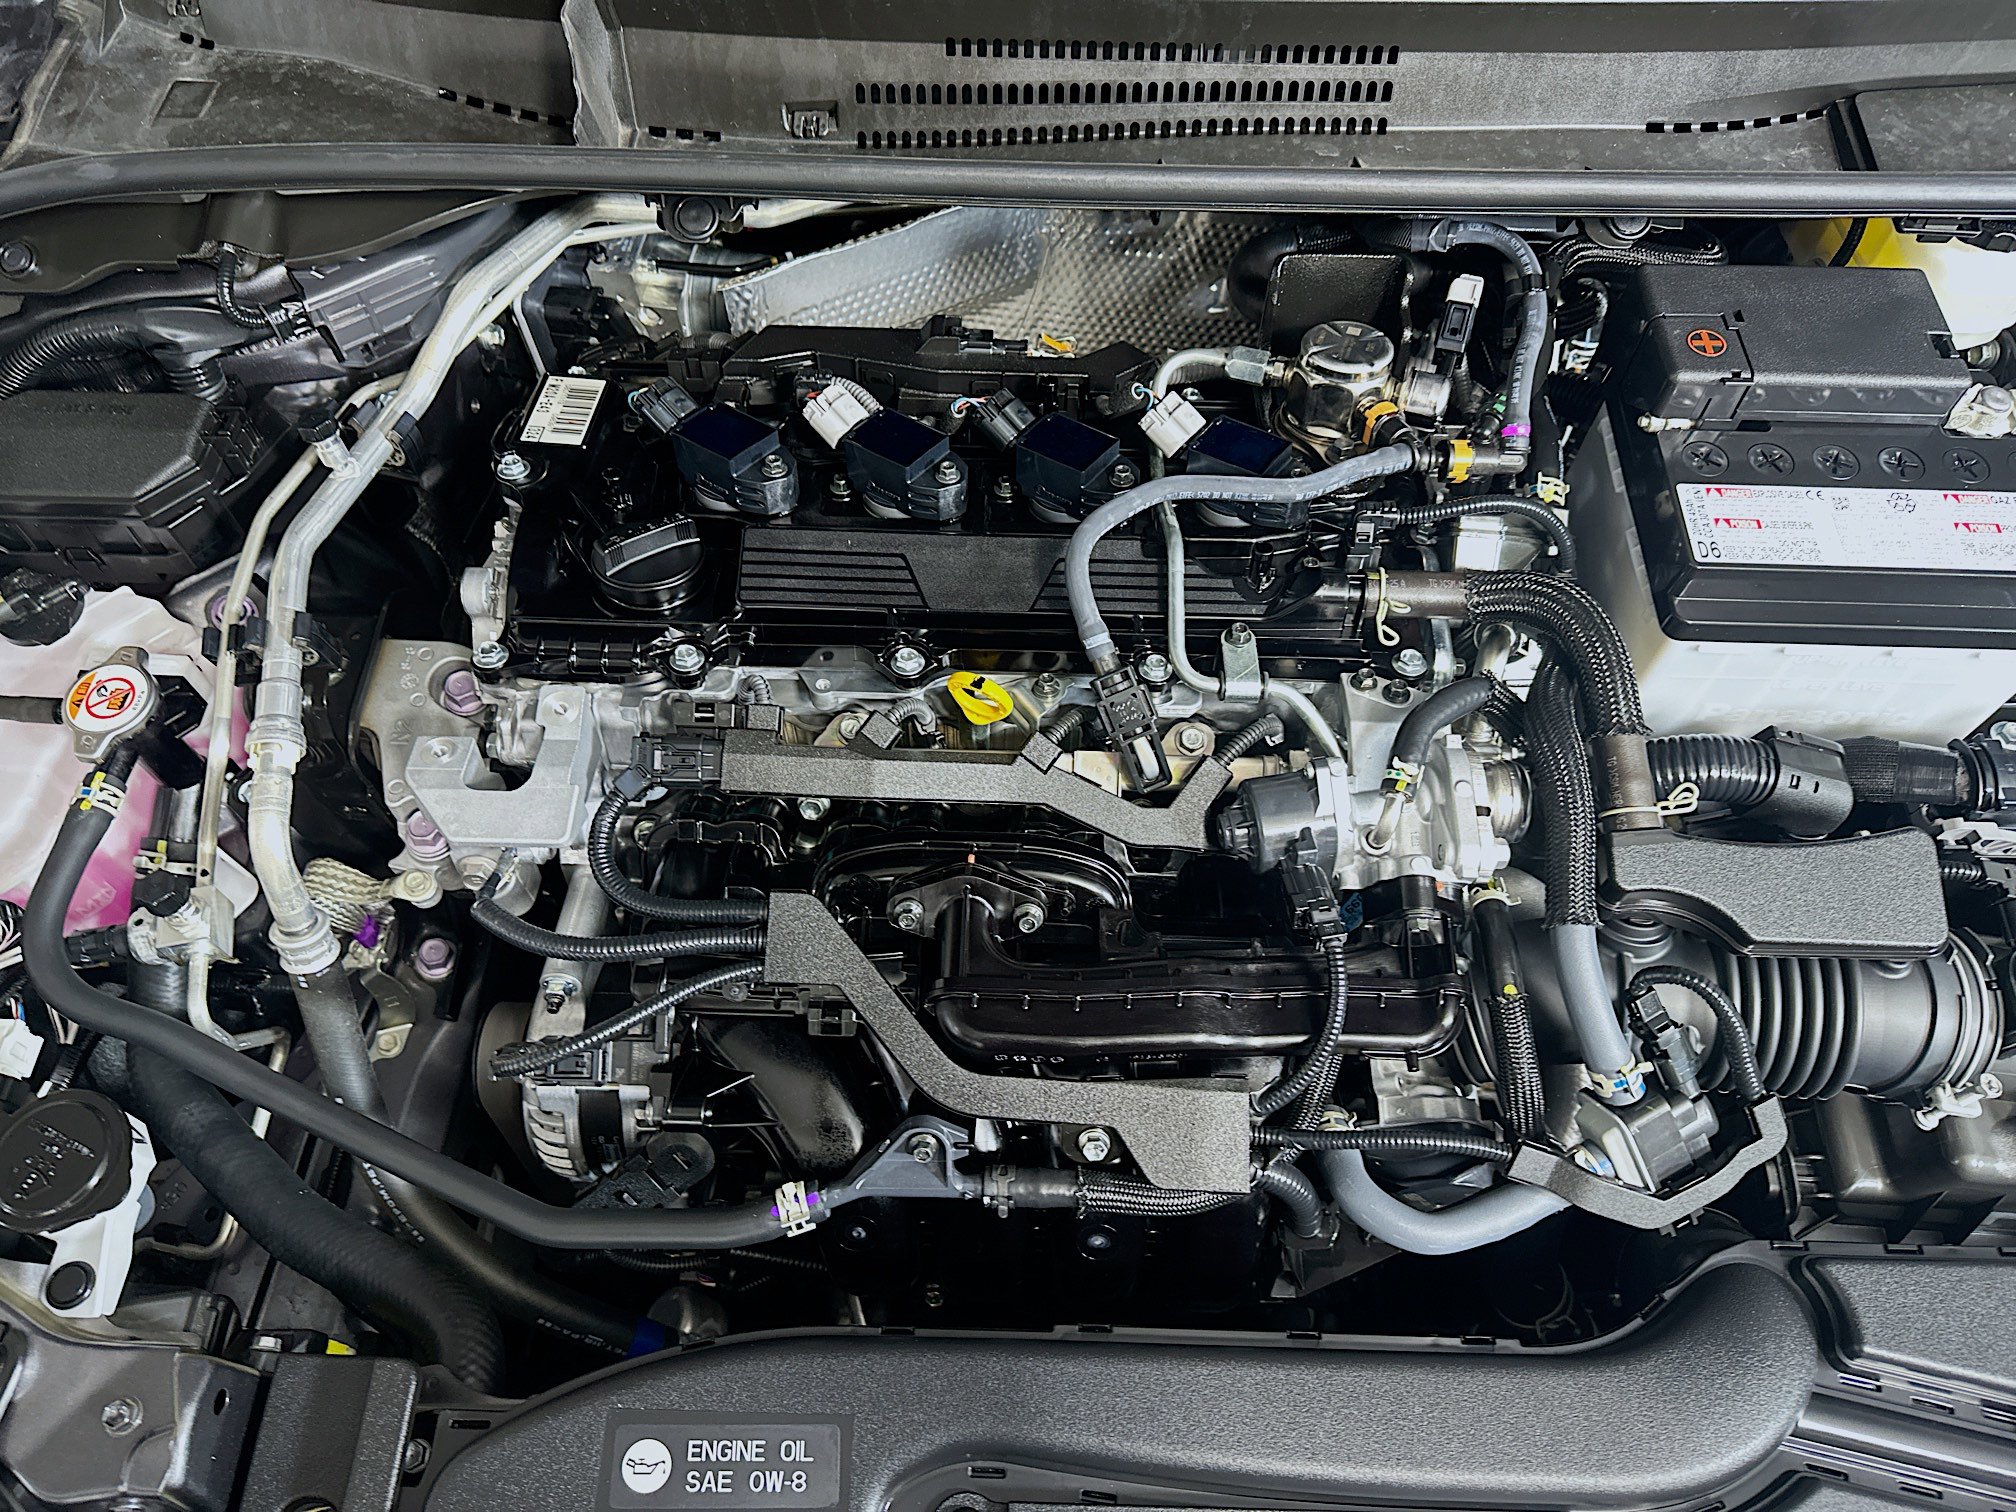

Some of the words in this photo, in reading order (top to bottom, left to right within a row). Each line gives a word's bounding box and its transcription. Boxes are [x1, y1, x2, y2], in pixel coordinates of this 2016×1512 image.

[1697, 541, 1722, 559] D6
[686, 1439, 767, 1463] ENGINE
[780, 1439, 815, 1463] OIL
[685, 1470, 734, 1493] SAE
[749, 1470, 808, 1493] 0W-8
